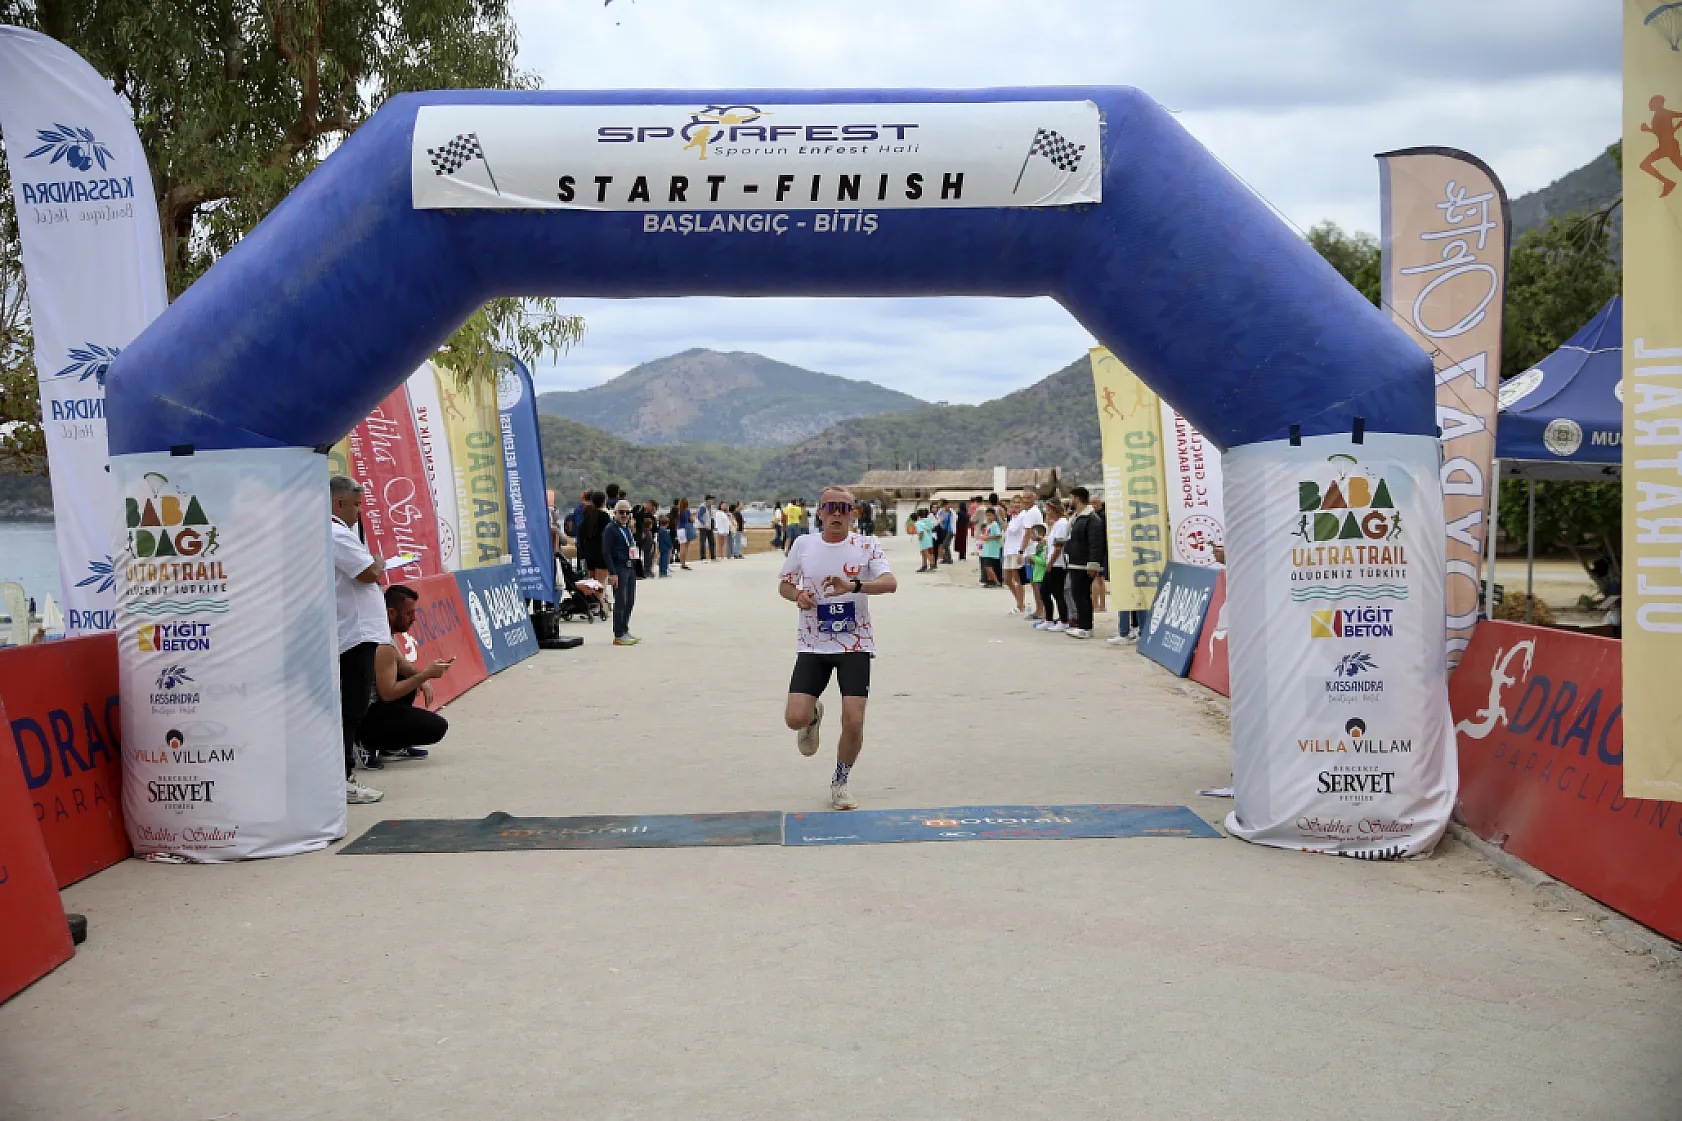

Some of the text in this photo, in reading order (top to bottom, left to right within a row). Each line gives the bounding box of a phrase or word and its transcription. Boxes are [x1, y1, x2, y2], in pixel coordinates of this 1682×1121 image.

[598, 122, 919, 144] SPORFEST
[714, 146, 787, 157] Sporun
[879, 143, 920, 153] Hali
[643, 213, 788, 235] BAŞLANGIÇ
[813, 209, 879, 235] BİTİŞ
[1591, 431, 1622, 445] MU
[1298, 477, 1394, 511] BABA
[126, 495, 209, 528] BABA
[1292, 545, 1408, 567] ULTRATRAIL
[126, 562, 227, 582] ULTRATRAIL
[411, 596, 461, 646] DRAGON
[1343, 606, 1393, 623] YİĞİT
[162, 621, 210, 637] YİĞİT
[1344, 624, 1393, 637] BETON
[163, 638, 209, 651] BETON
[1325, 680, 1383, 692] KASSANDRA
[150, 693, 200, 705] KASSANDRA
[148, 780, 215, 802] SERVET
[1317, 771, 1395, 795] SERVET
